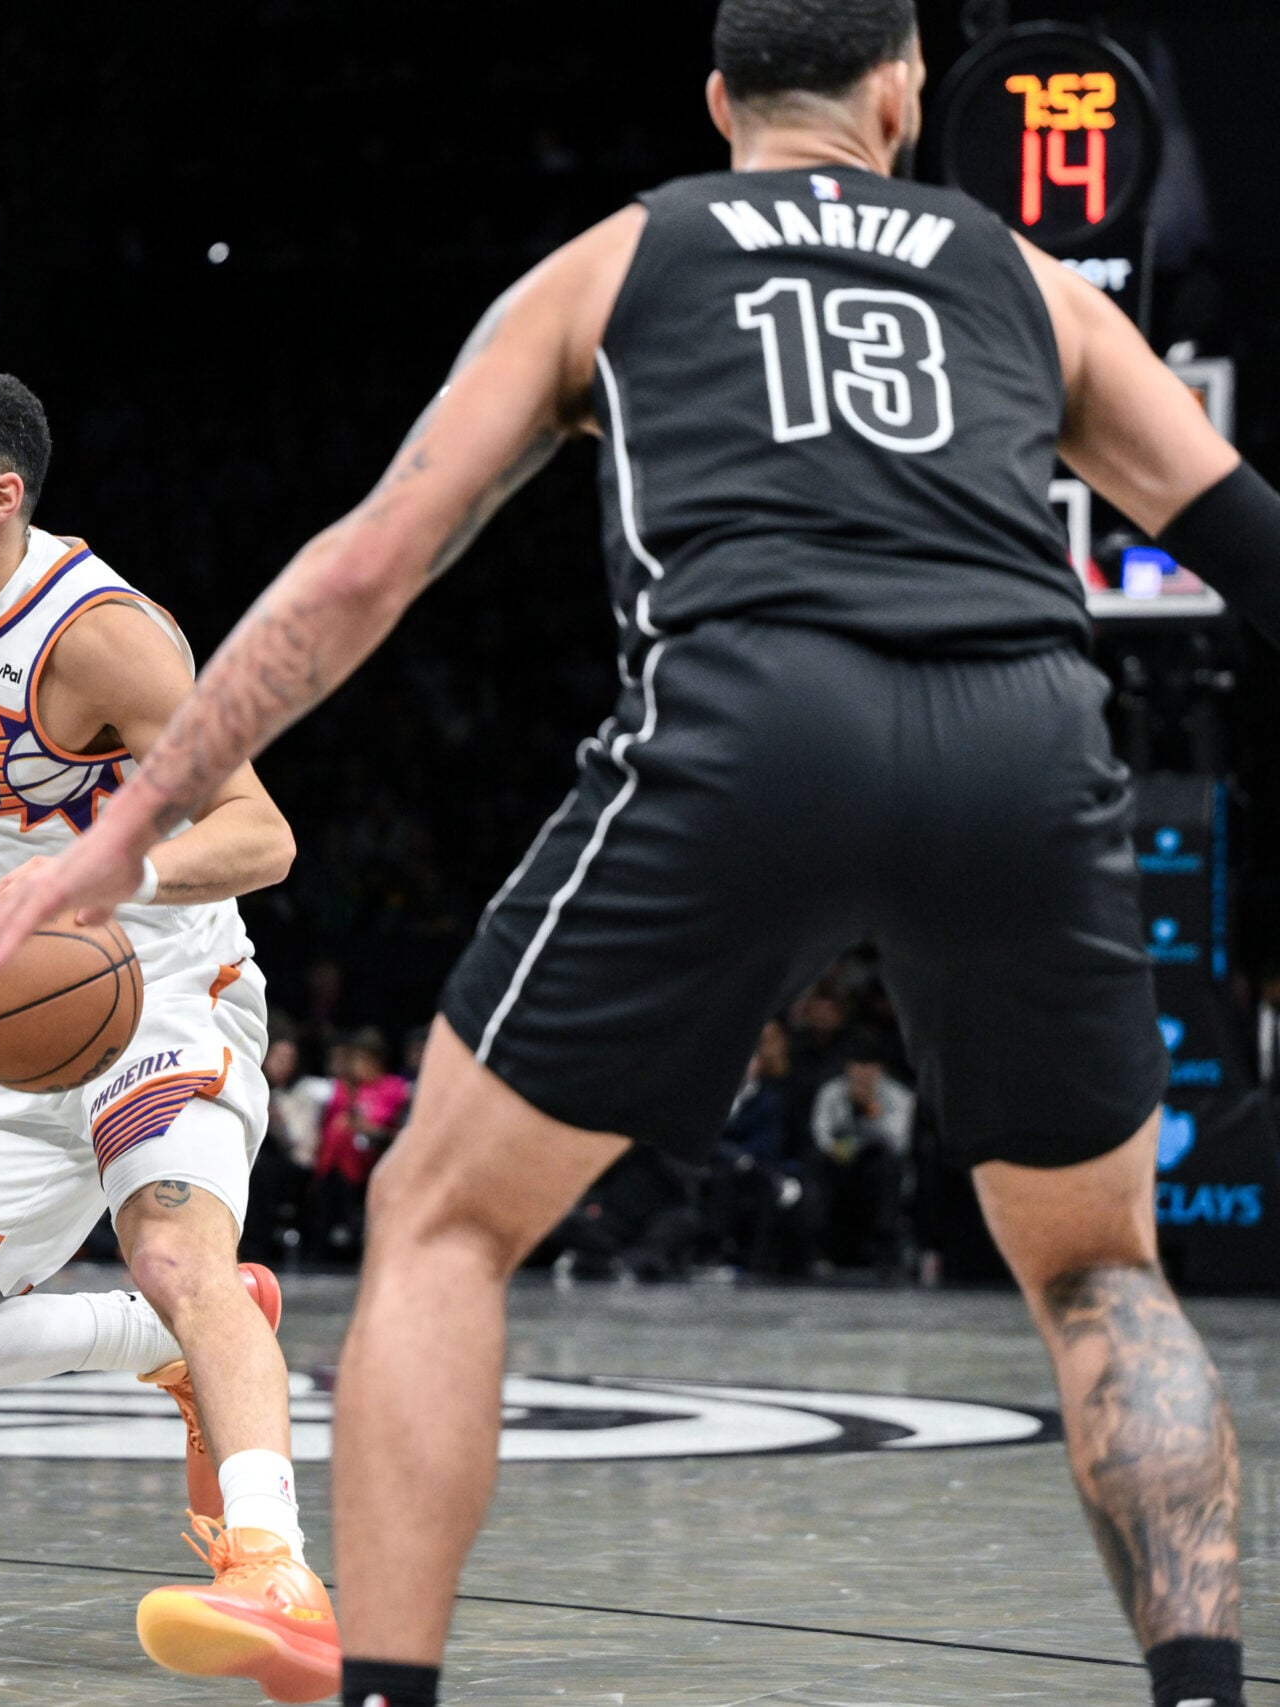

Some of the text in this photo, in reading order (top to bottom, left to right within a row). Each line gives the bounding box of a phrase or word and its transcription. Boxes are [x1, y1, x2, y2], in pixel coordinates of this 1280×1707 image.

[1005, 72, 1116, 131] 7:52
[1022, 128, 1106, 226] 14
[709, 200, 955, 269] MARTIN
[734, 277, 954, 453] 13
[90, 1048, 184, 1125] PHOENIX
[1156, 1183, 1262, 1225] CLAYS
